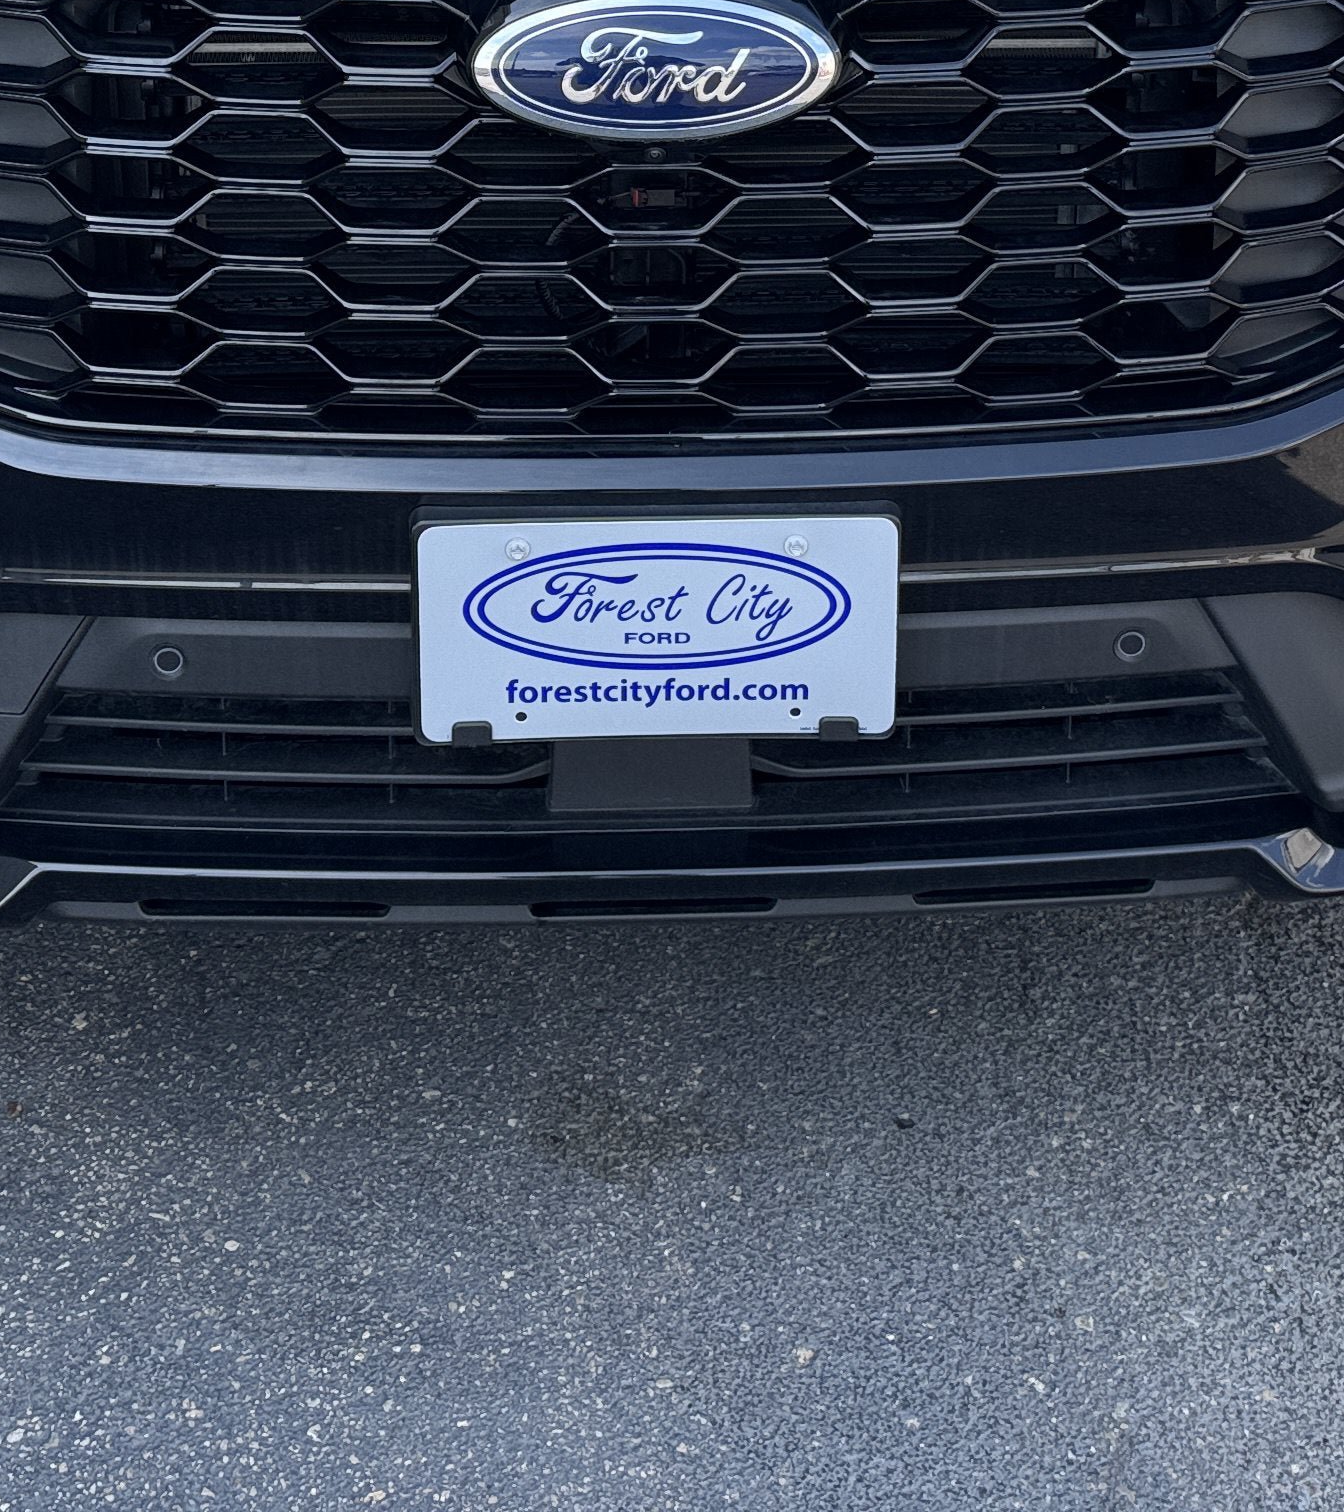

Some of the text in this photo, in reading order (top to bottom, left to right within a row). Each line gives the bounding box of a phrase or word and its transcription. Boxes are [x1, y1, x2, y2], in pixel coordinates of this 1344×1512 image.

[561, 26, 751, 104] Ford
[530, 571, 794, 642] Forest City
[623, 631, 691, 645] FORD
[505, 677, 810, 709] forestcityford.com
